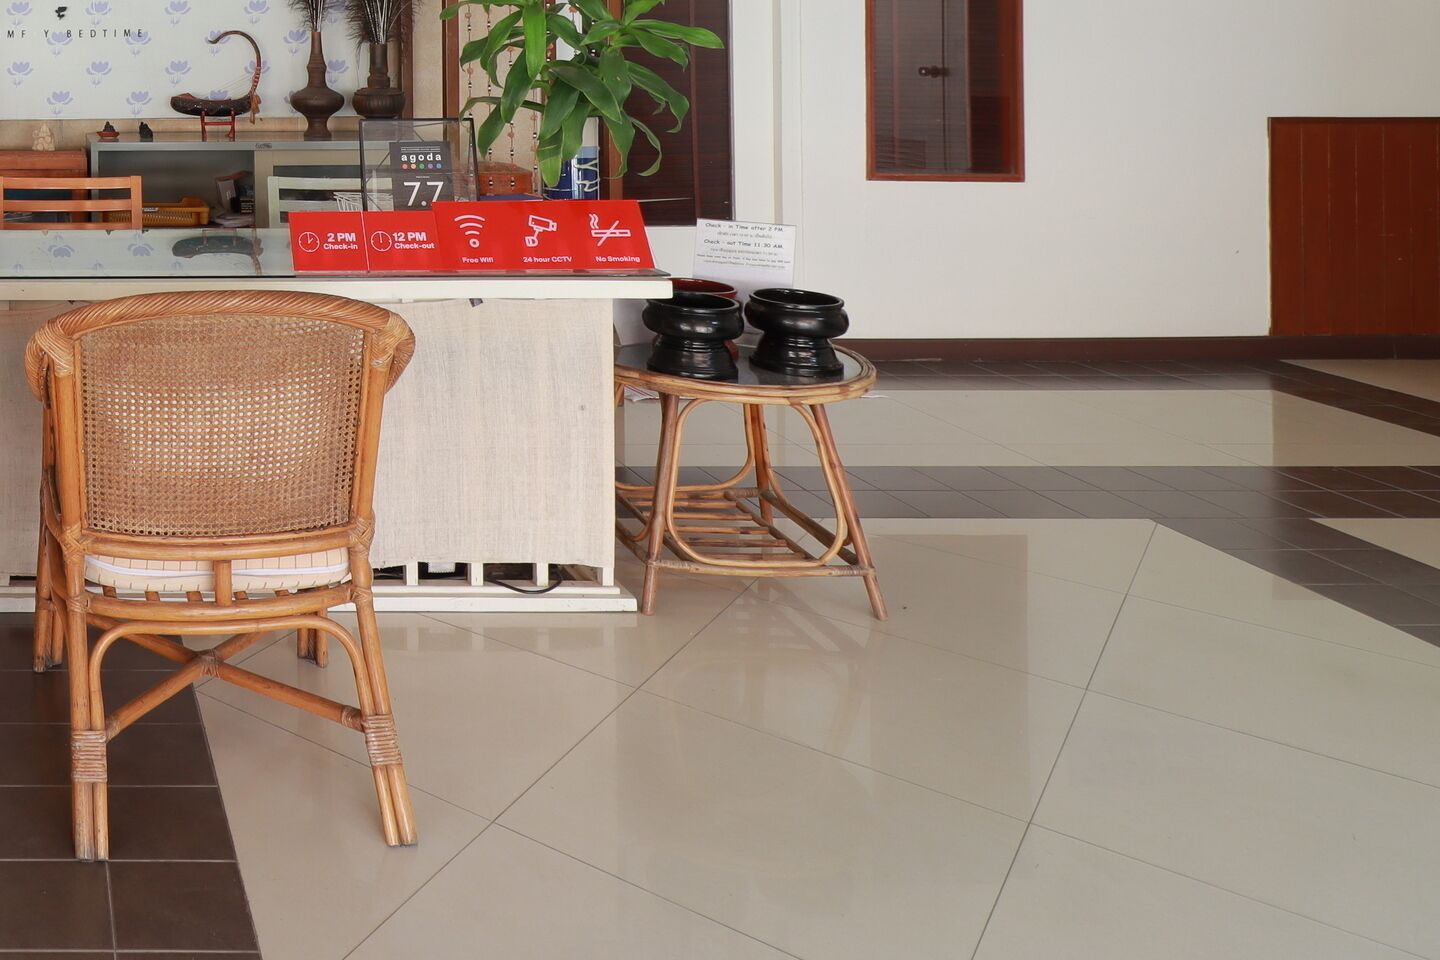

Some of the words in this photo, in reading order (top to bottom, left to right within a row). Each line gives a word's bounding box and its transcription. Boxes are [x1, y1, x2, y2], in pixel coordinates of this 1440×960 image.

[66, 28, 143, 38] BEDTIME
[401, 153, 441, 163] agoda
[403, 181, 444, 207] 7.7
[327, 233, 335, 241] 2
[337, 233, 356, 241] PM
[392, 232, 405, 241] 12
[407, 232, 427, 241] PM
